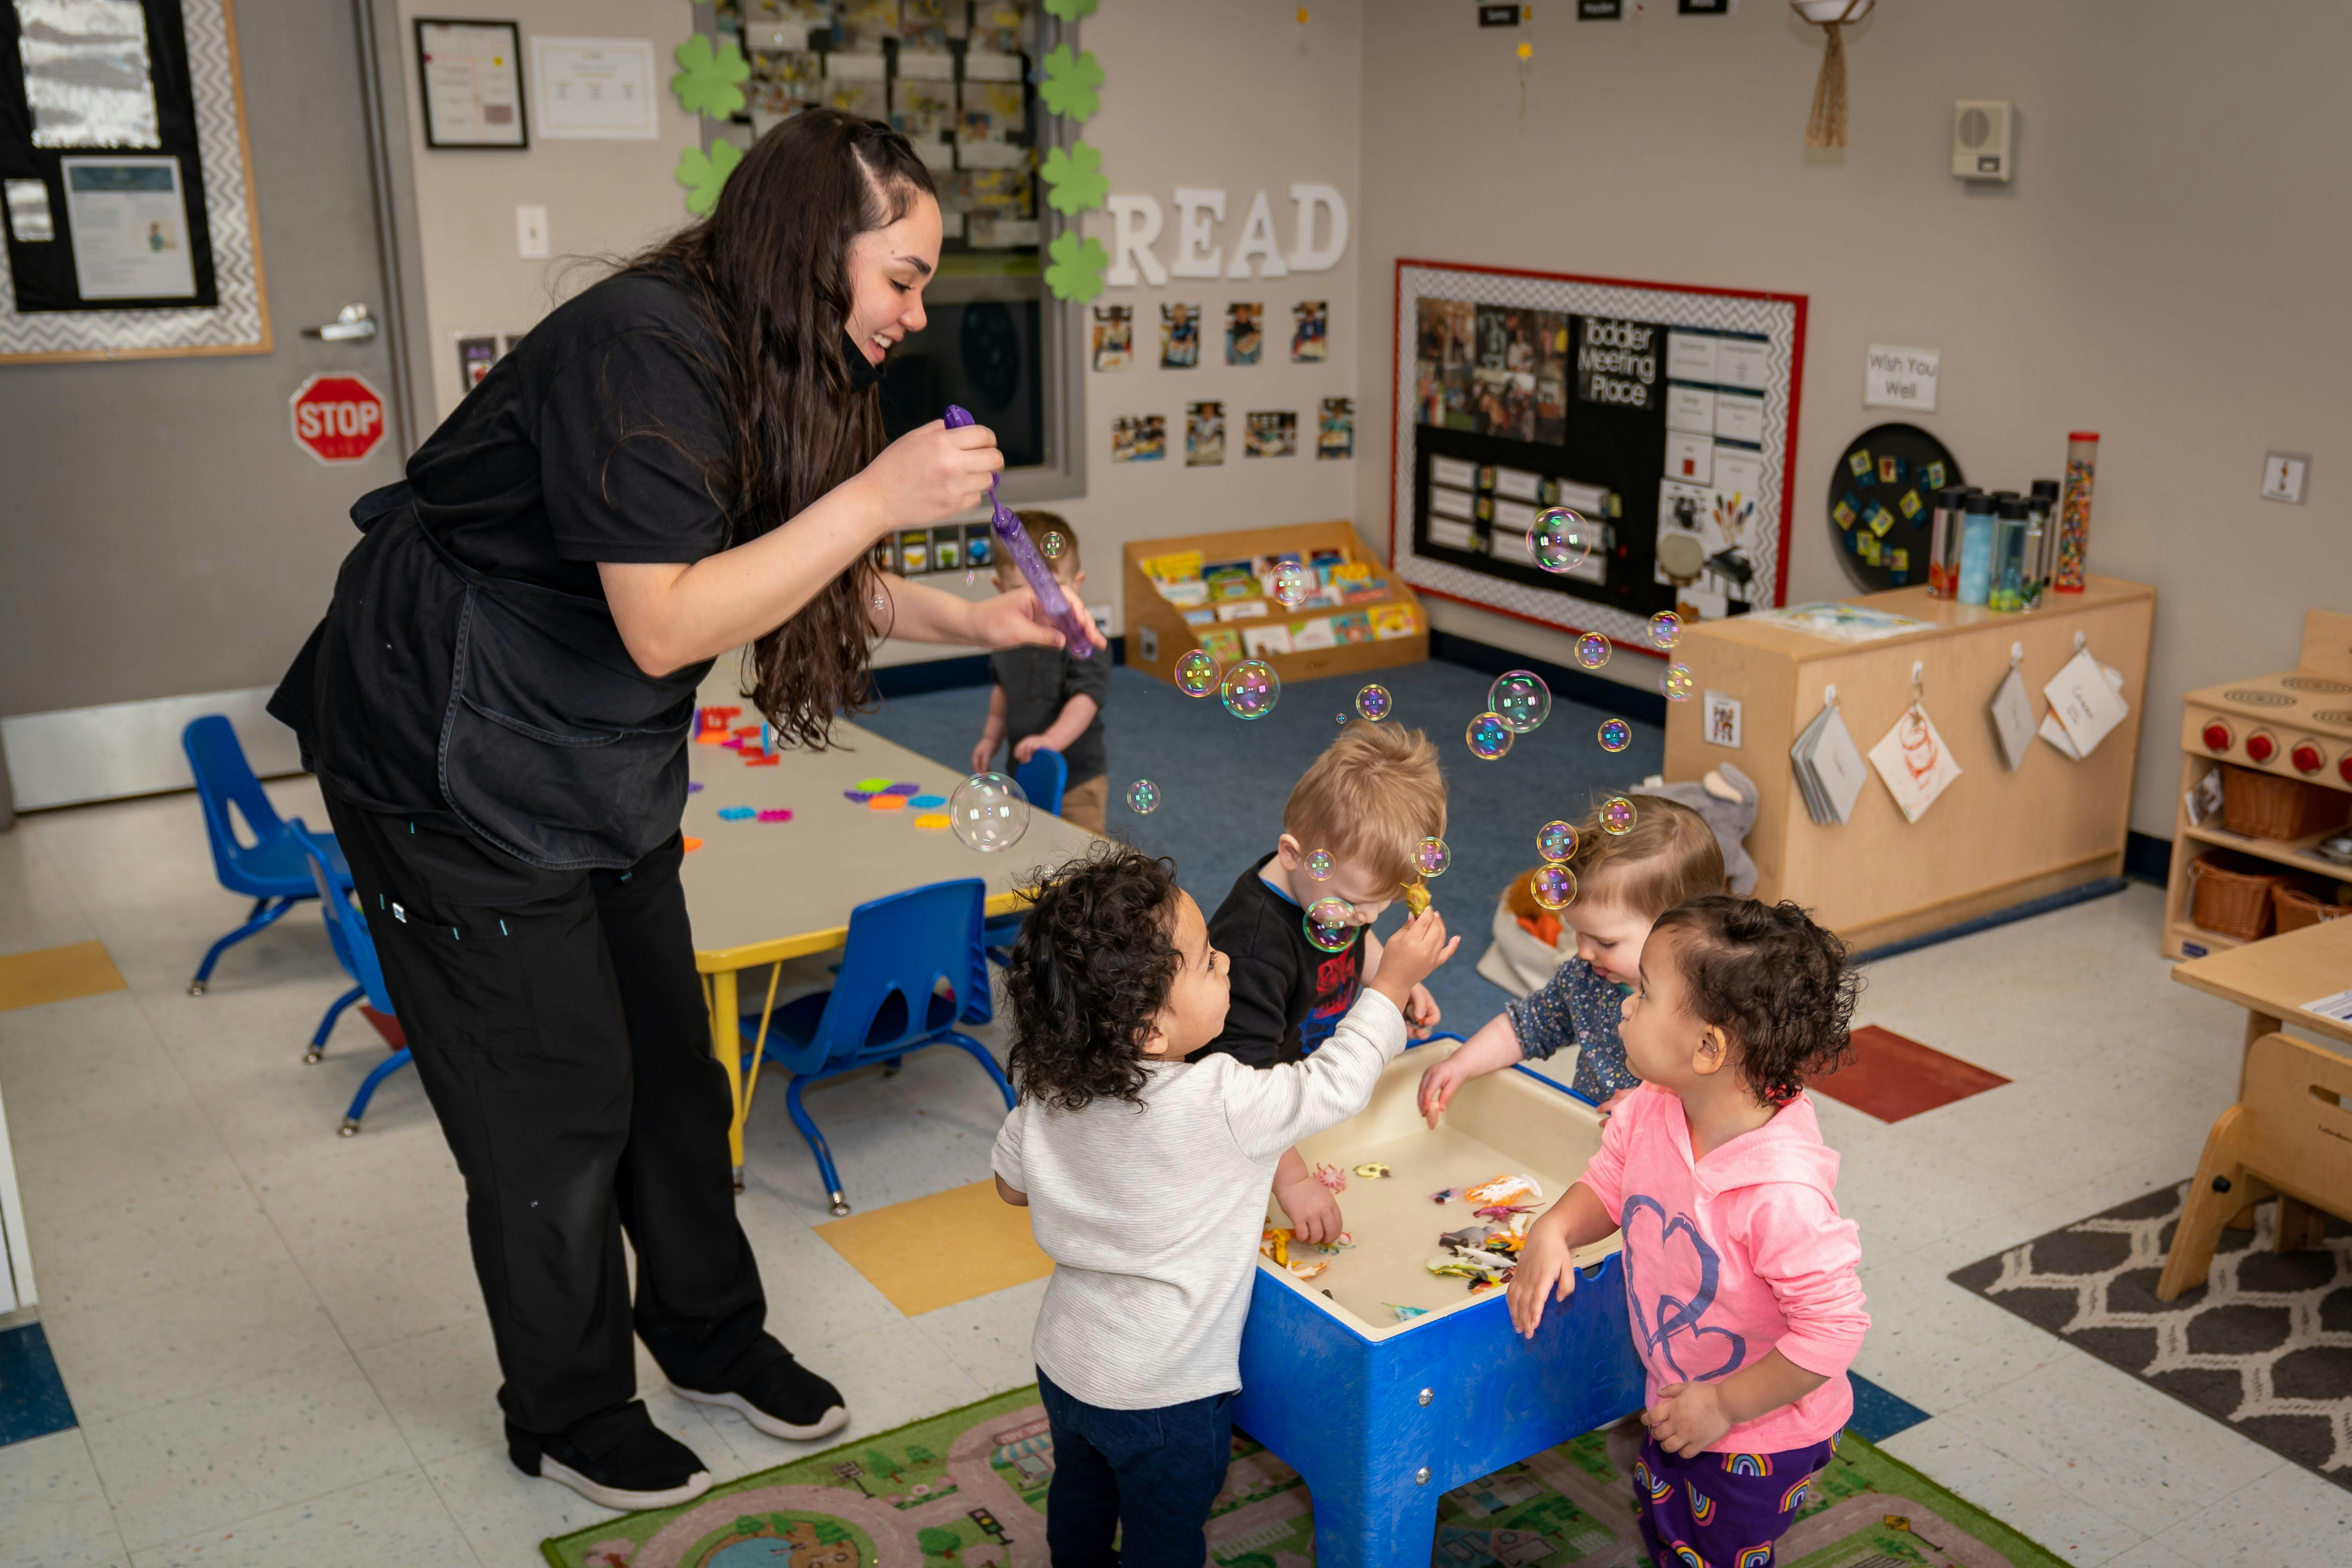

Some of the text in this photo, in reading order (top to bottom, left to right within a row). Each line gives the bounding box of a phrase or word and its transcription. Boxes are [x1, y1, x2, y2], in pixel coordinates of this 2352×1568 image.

[1107, 184, 1349, 286] READ
[1586, 318, 1654, 350] Toddler
[1577, 346, 1656, 385] Meeting
[1869, 353, 1936, 376] Wish You
[1591, 373, 1648, 406] Place
[1885, 380, 1917, 399] Well
[299, 401, 380, 439] STOP
